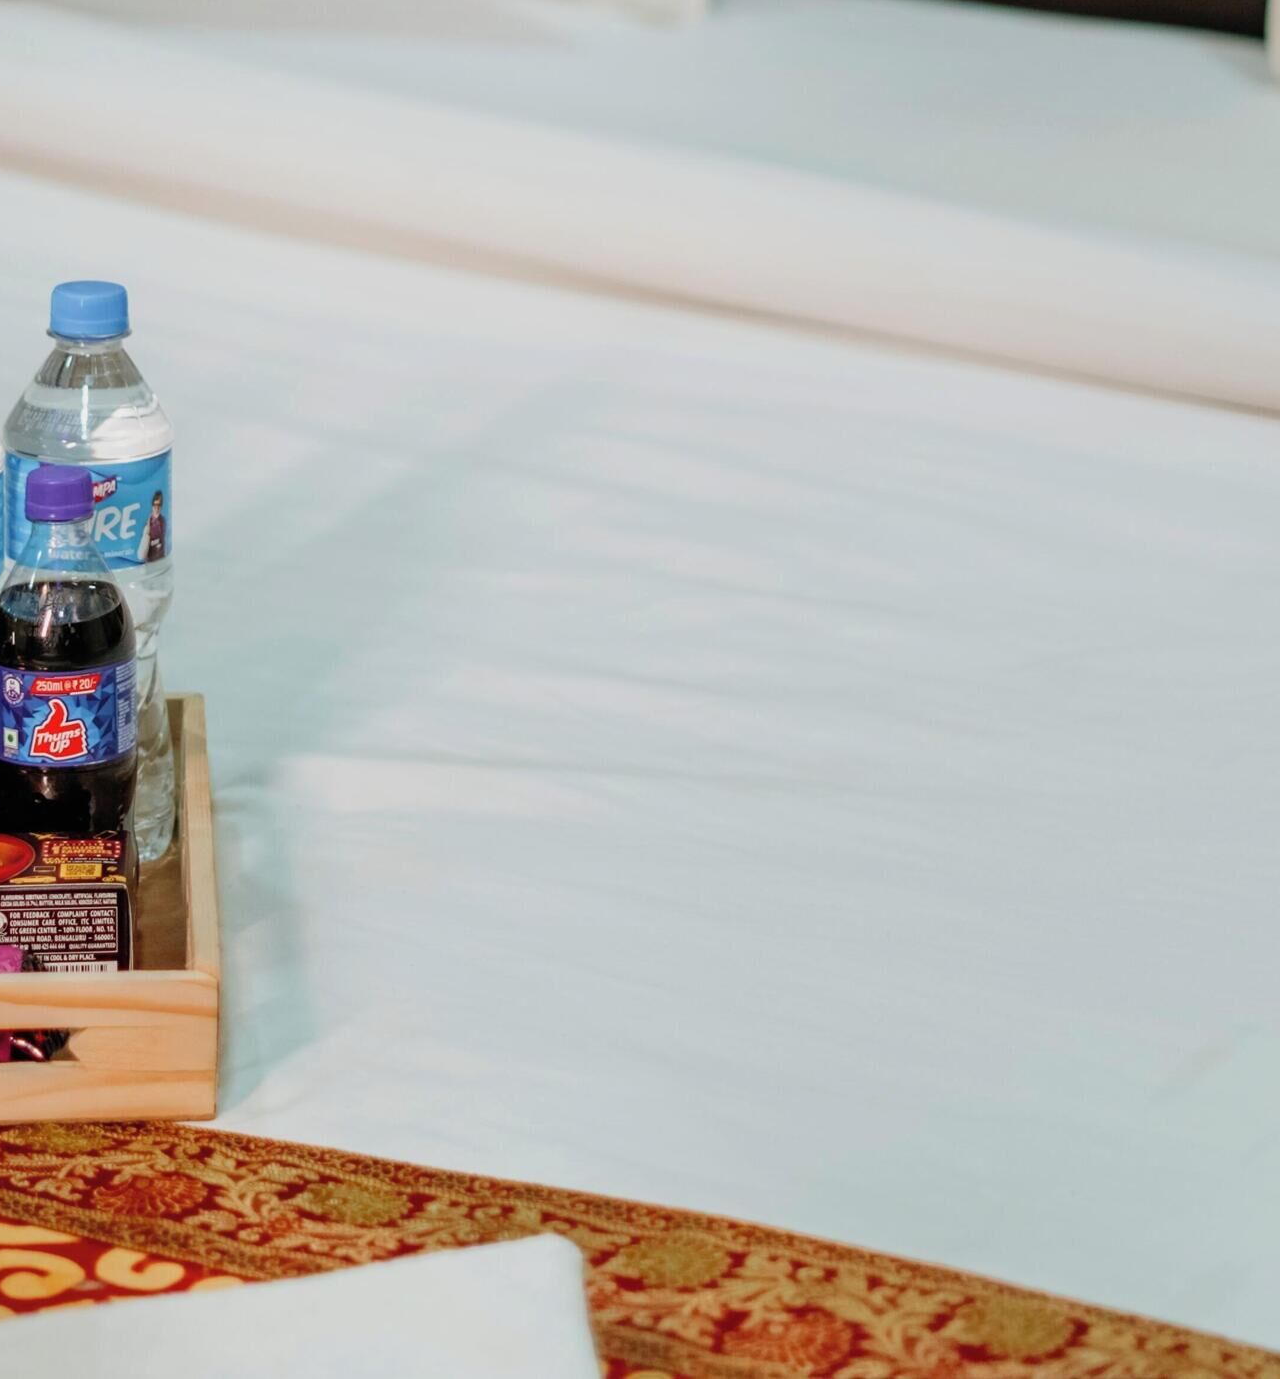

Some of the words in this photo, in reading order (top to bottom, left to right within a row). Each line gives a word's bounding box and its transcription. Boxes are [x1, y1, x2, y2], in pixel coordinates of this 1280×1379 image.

[39, 680, 63, 691] 250ml
[36, 728, 81, 745] Thums
[10, 911, 21, 919] FOR
[57, 910, 88, 918] COMPLAINT
[10, 919, 39, 927] CONSUMER
[20, 935, 35, 943] MAIN
